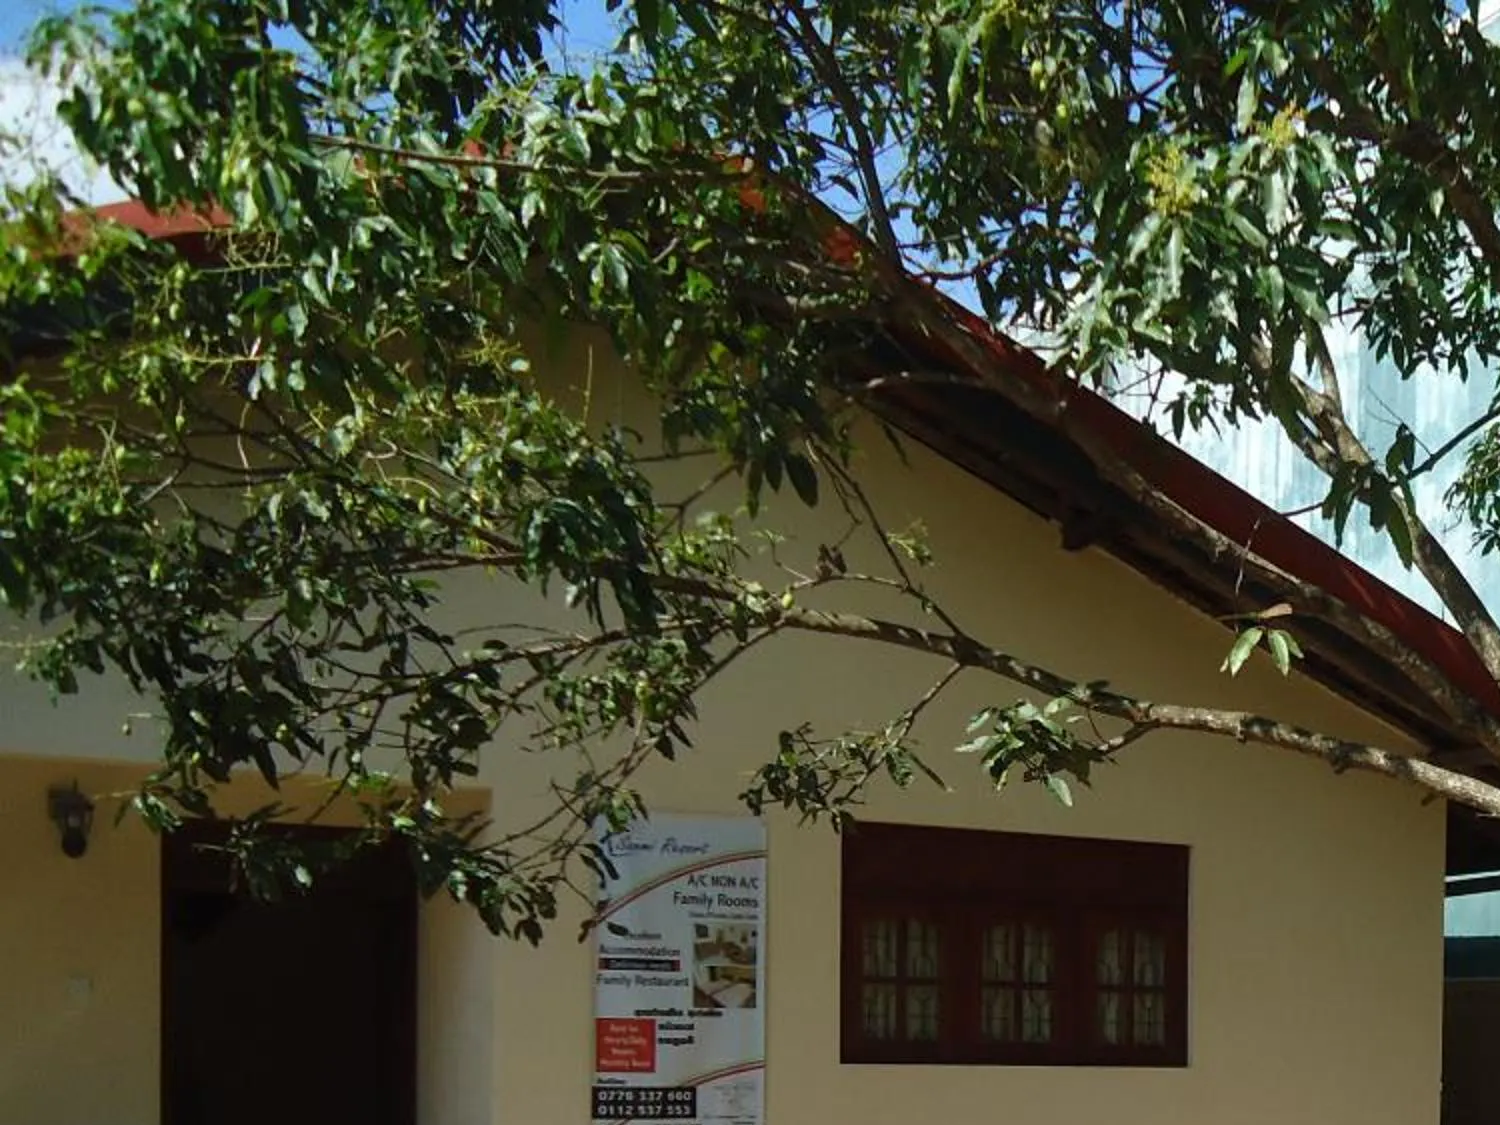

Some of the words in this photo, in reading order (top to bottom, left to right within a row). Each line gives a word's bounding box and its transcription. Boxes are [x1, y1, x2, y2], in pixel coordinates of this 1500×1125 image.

[739, 876, 759, 890] A/C
[673, 891, 713, 910] Family
[717, 893, 759, 909] Rooms
